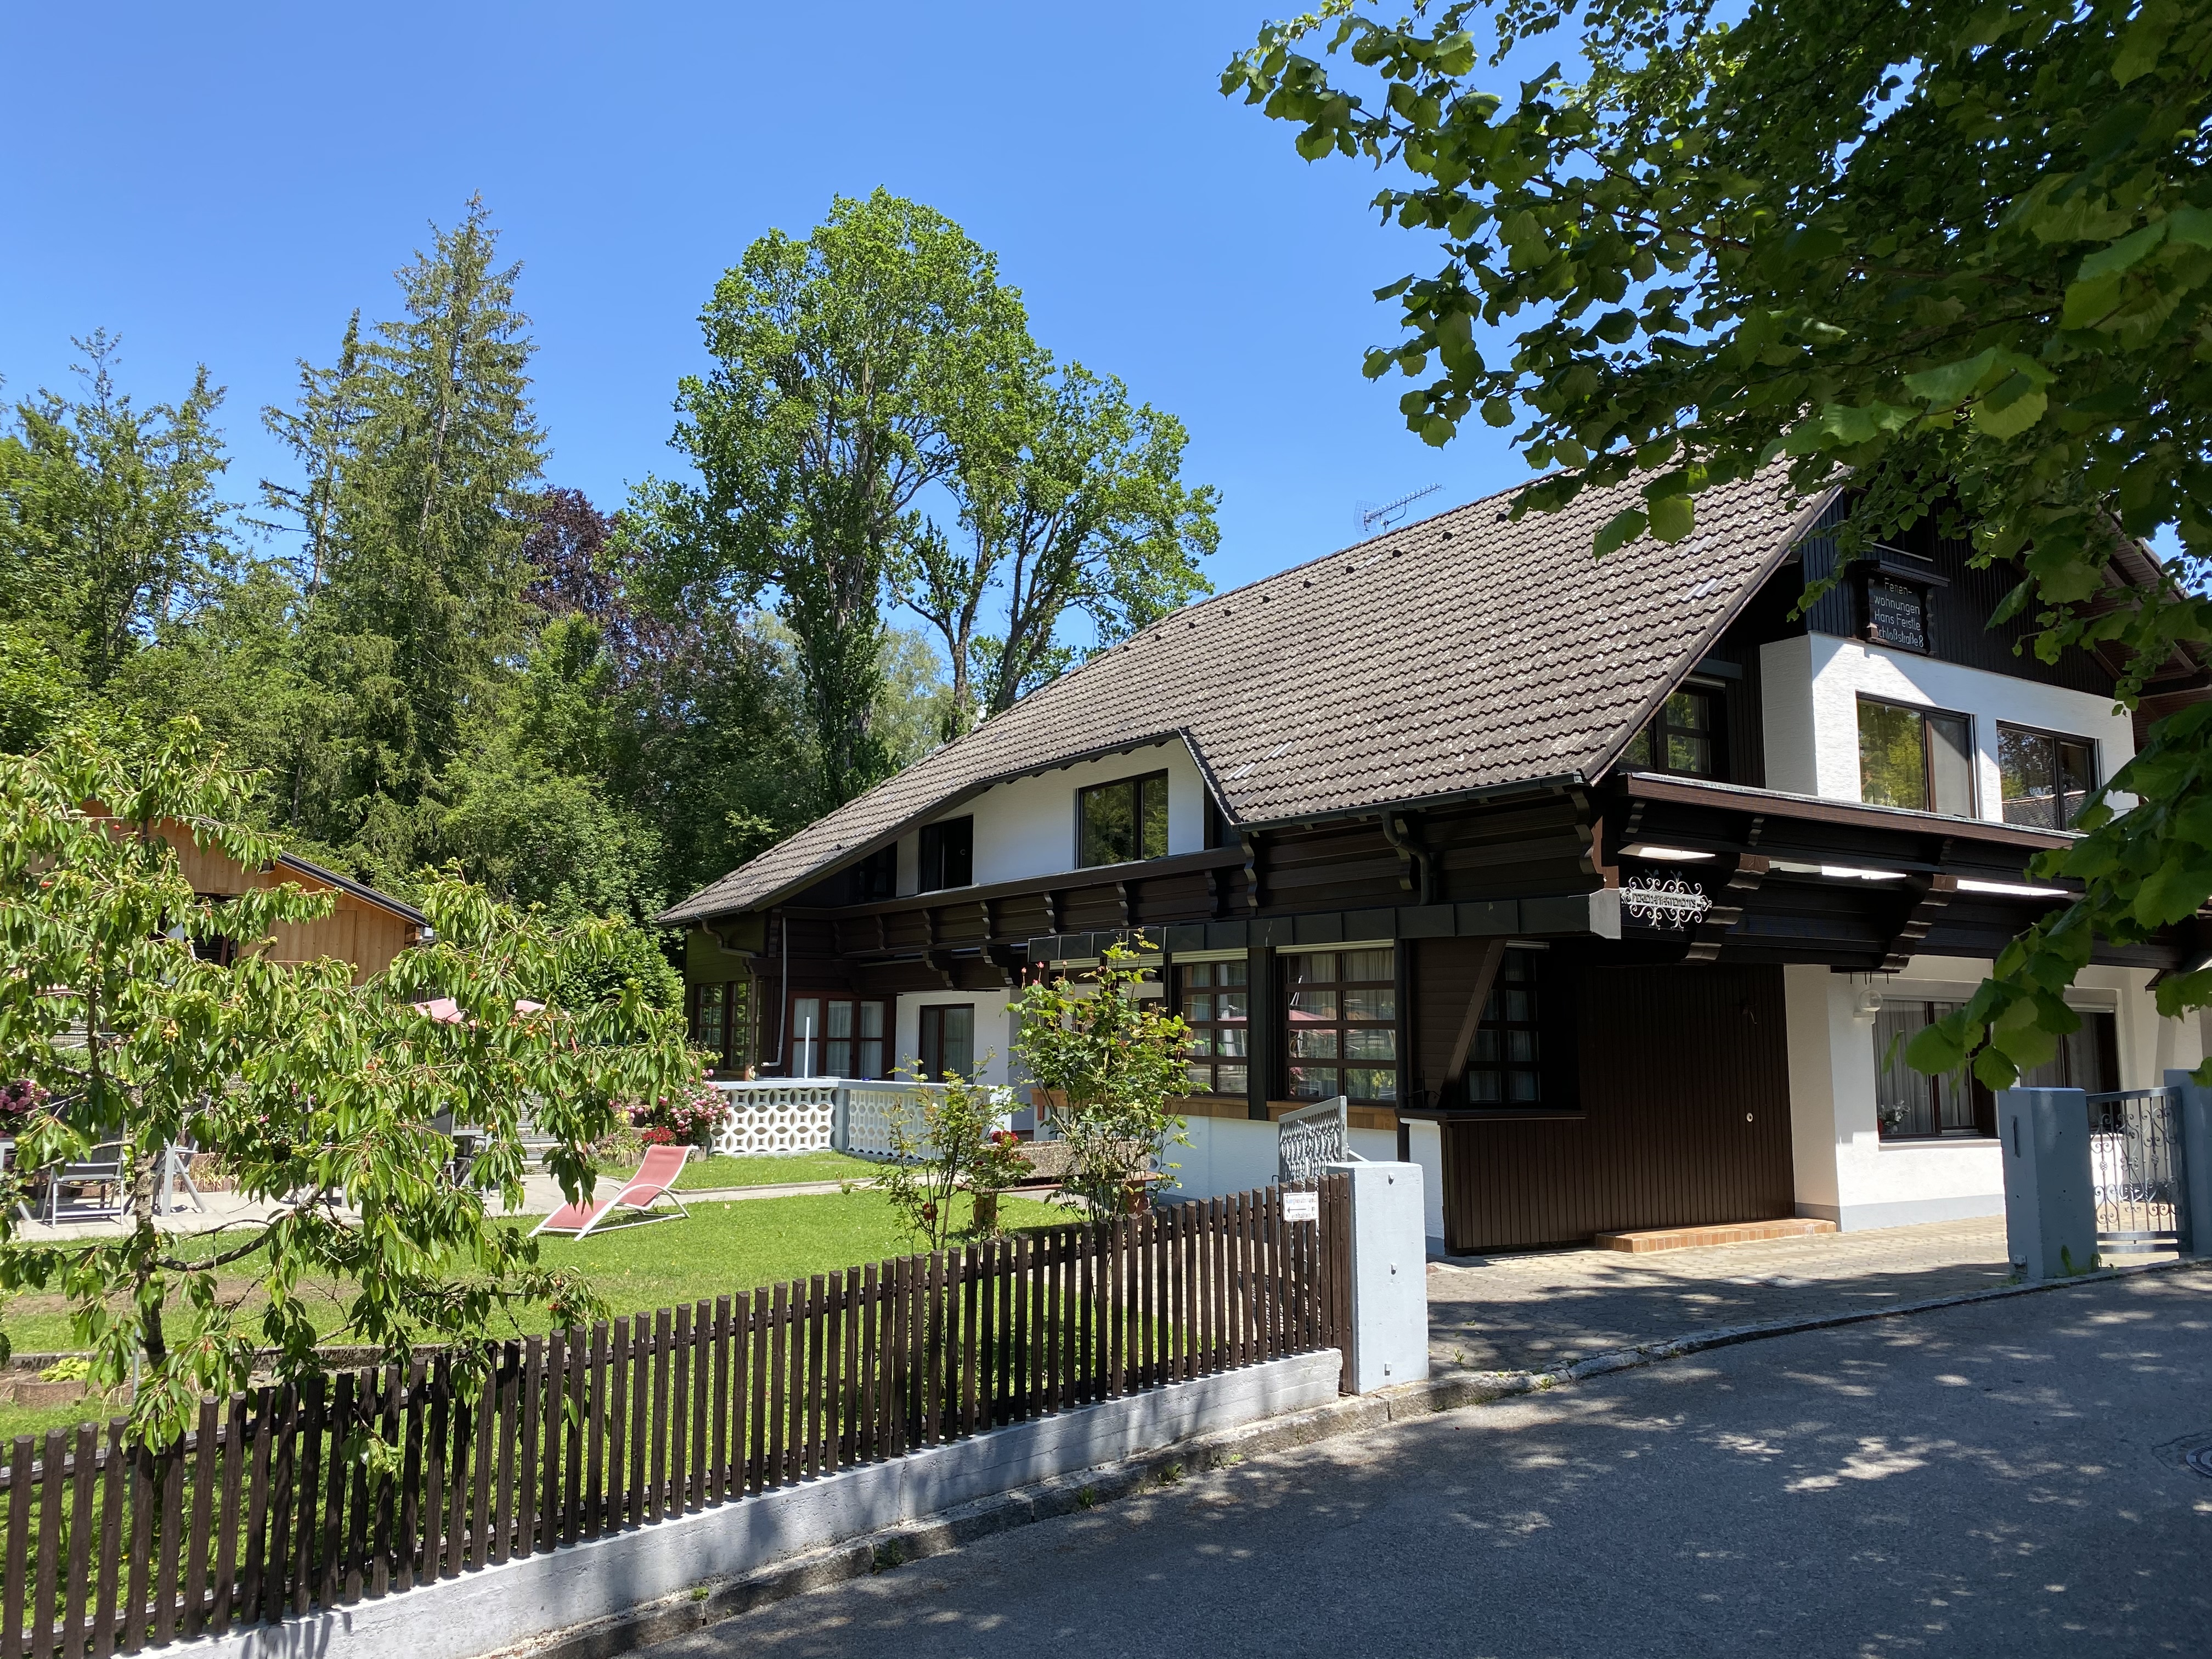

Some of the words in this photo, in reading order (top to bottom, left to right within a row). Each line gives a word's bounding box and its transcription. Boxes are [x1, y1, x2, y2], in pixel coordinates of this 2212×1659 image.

[1874, 594, 1920, 615] wohnungen
[1874, 608, 1894, 624] Hans
[1897, 613, 1921, 631] Feistle
[1878, 626, 1918, 646] chloßstraße
